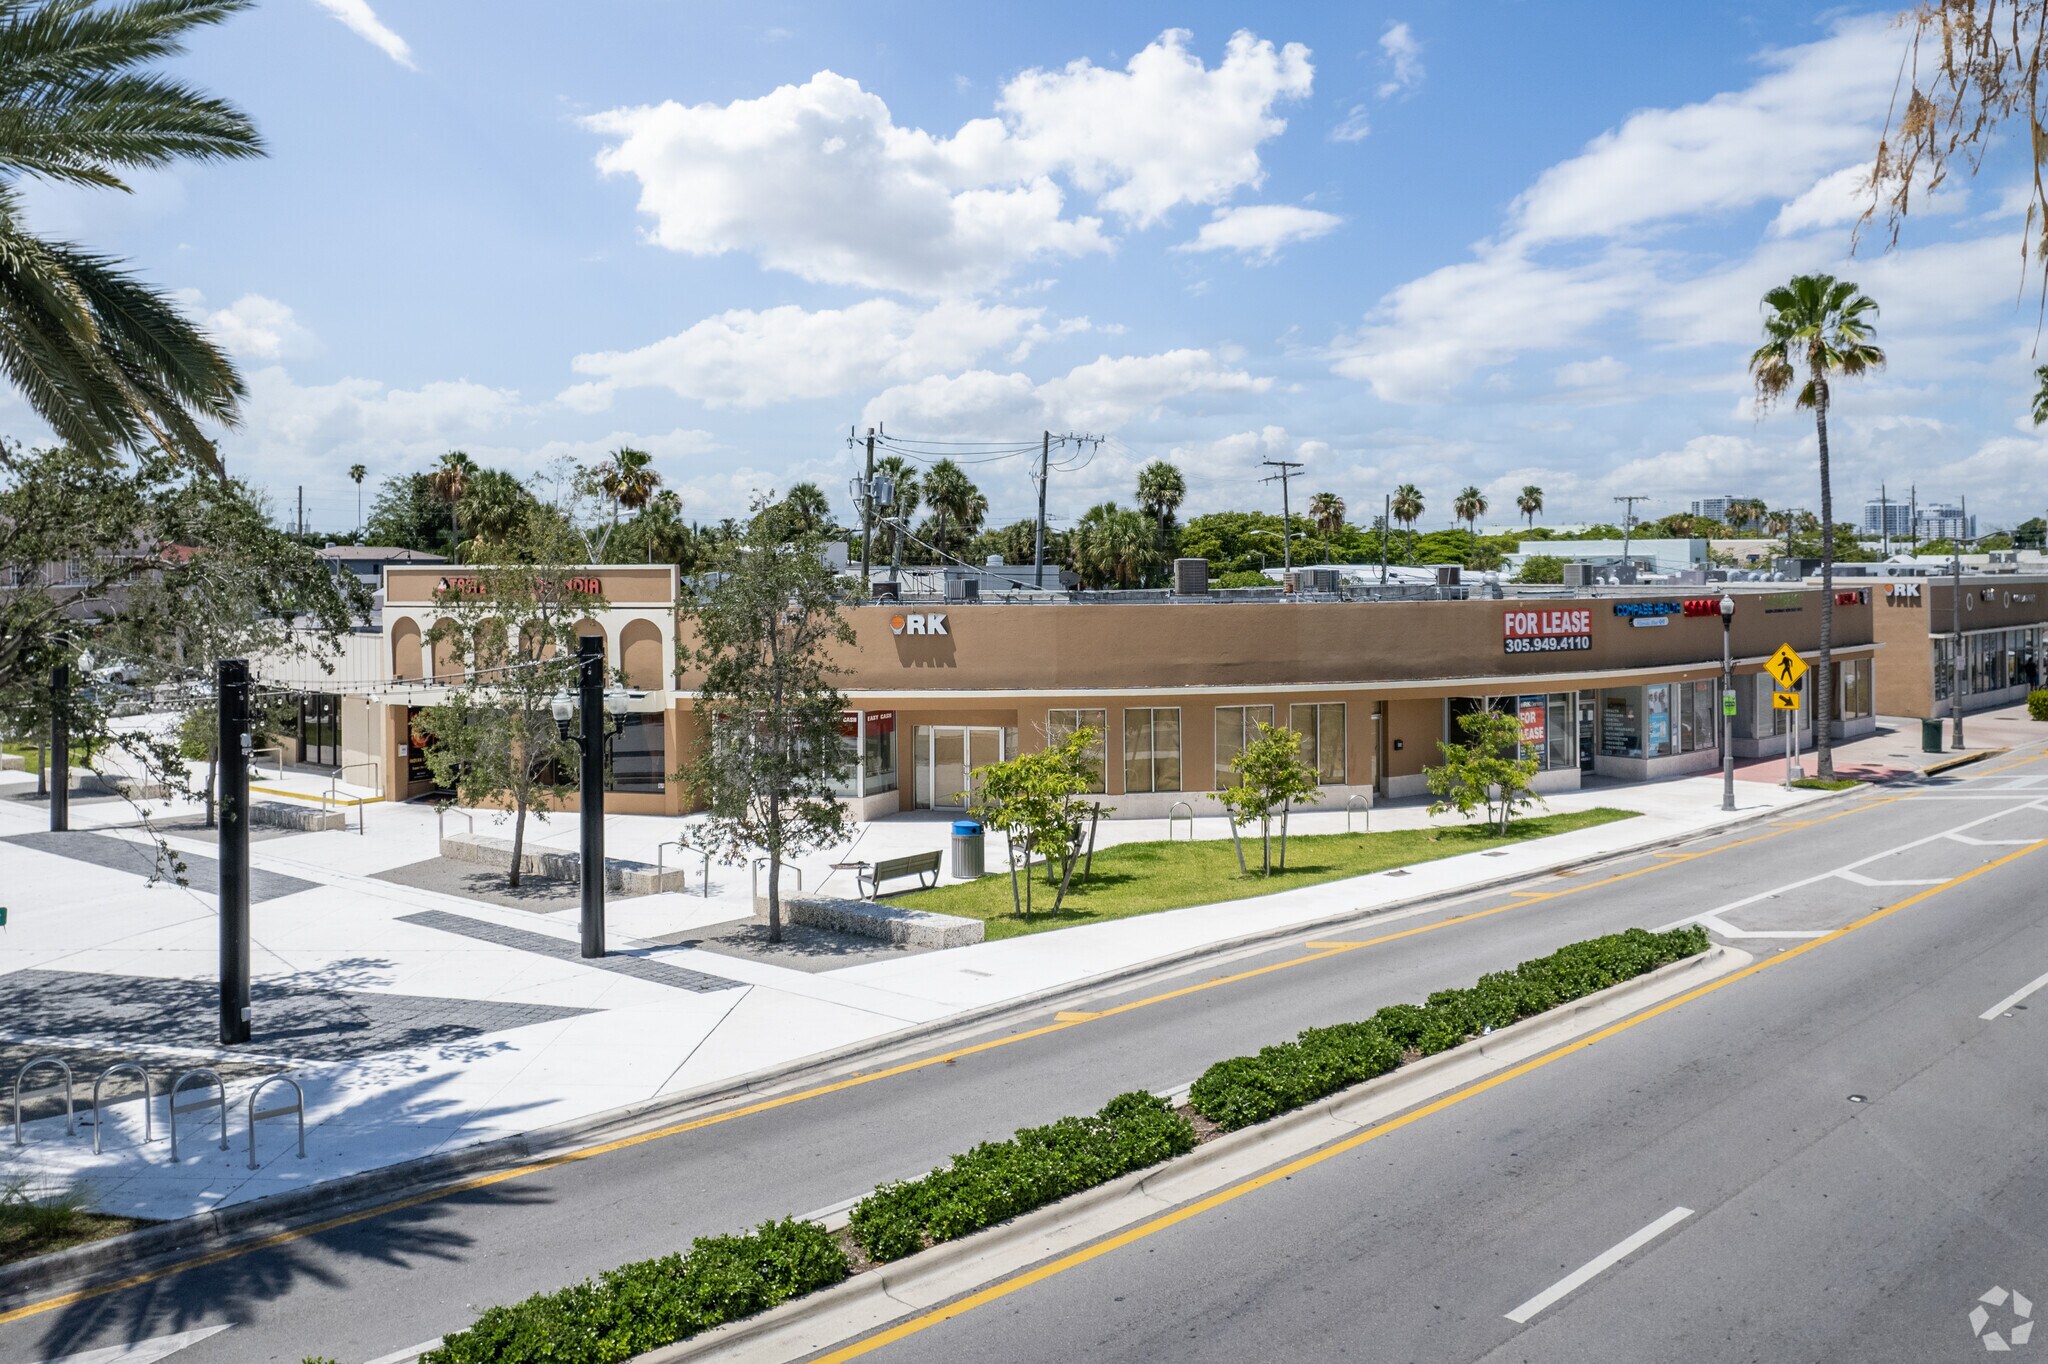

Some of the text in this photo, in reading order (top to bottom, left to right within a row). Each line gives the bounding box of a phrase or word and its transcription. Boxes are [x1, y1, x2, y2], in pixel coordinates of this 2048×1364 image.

[1894, 584, 1920, 597] RK
[1615, 603, 1653, 617] COMPASS
[1654, 602, 1680, 614] HEALTH
[906, 613, 948, 635] RK
[1505, 611, 1590, 635] FOR LEASE
[1505, 636, 1590, 653] 305.949.4110
[867, 712, 892, 722] EASY CASH
[1520, 711, 1536, 724] FOR
[1520, 726, 1544, 741] LEASE
